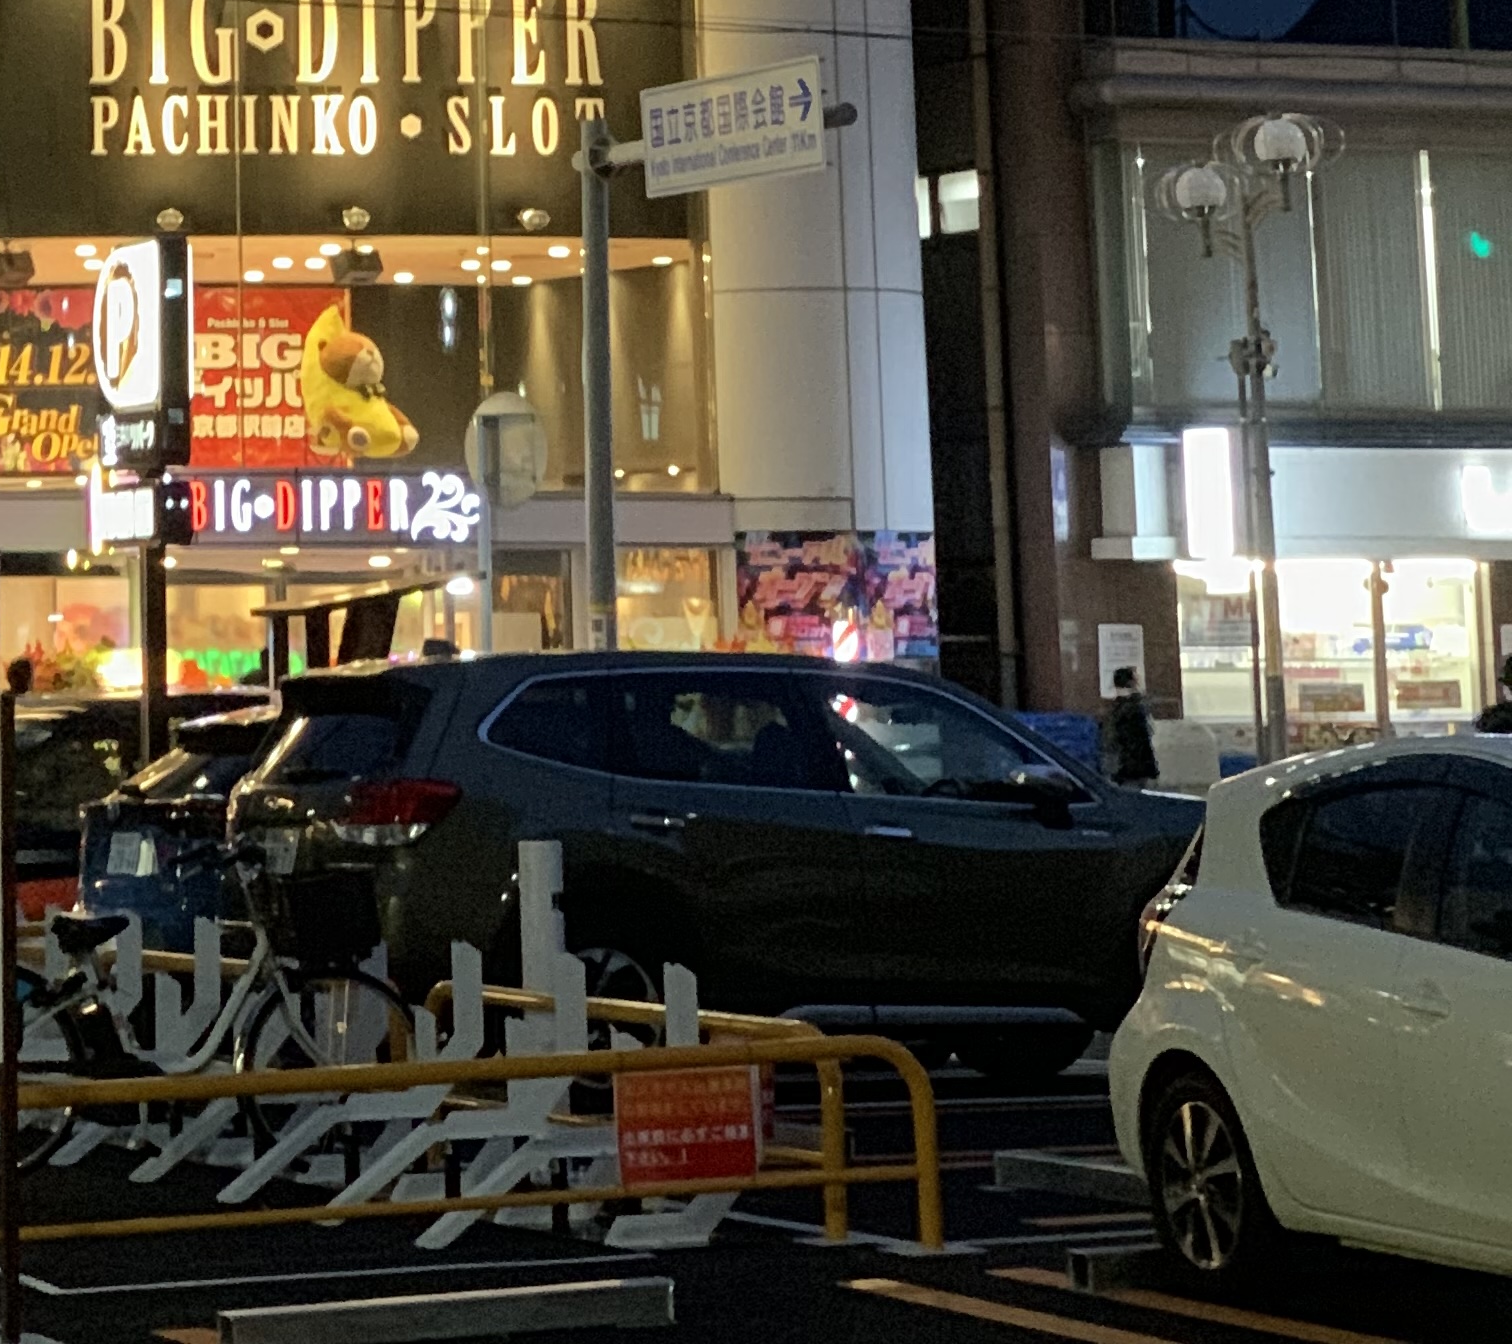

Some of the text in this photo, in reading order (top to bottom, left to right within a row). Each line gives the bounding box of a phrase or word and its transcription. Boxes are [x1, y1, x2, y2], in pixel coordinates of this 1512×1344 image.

[89, 94, 378, 156] PACHINKO
[193, 333, 303, 370] BIG
[190, 478, 254, 532] BIG
[275, 478, 410, 532] DIPPER
